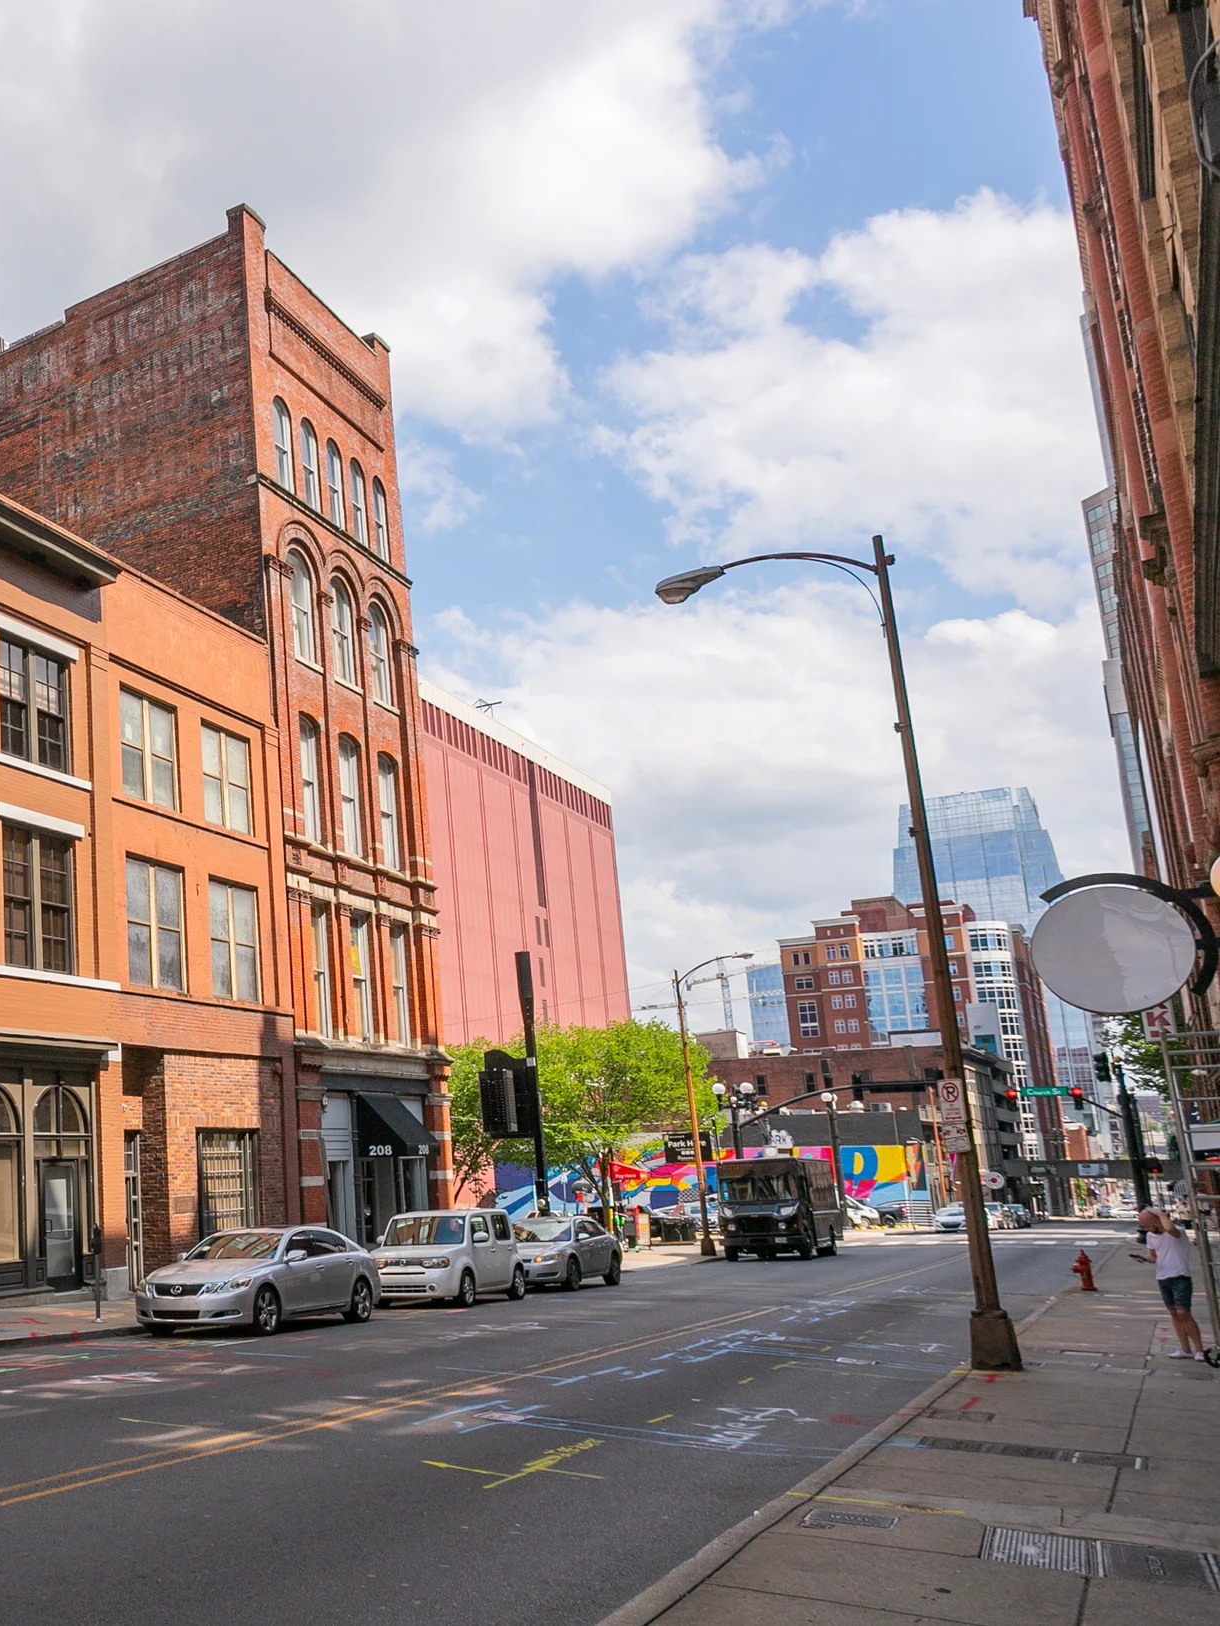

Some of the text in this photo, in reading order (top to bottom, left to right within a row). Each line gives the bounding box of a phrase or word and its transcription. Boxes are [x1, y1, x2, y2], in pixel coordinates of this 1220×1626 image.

[418, 1144, 430, 1155] 208
[667, 1140, 686, 1148] Park
[368, 1145, 393, 1156] 208
